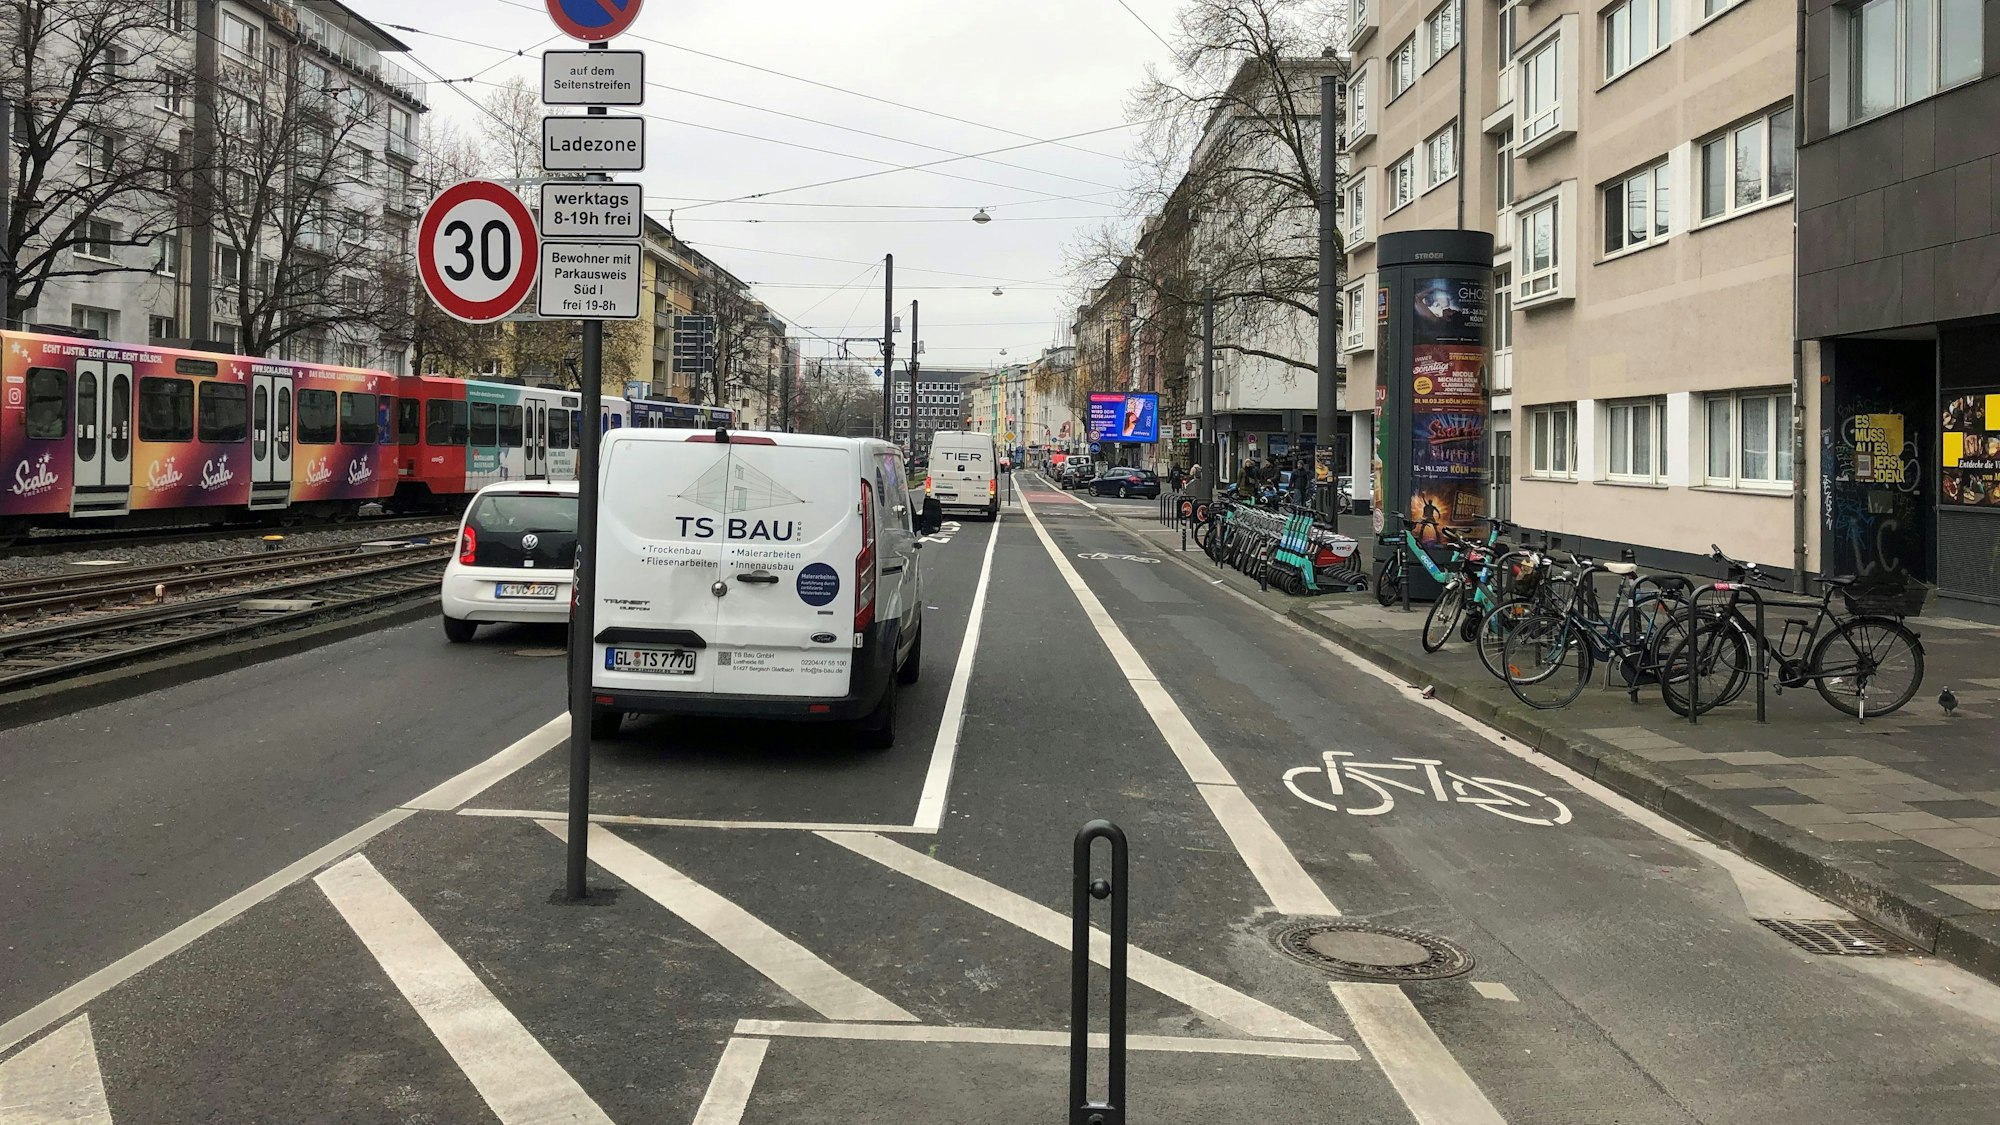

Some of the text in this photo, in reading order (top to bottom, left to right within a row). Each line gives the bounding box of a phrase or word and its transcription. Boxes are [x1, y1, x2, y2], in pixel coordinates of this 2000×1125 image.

[569, 66, 614, 76] auf dem
[553, 79, 631, 90] Seitenstreifen
[549, 136, 637, 152] Ladezone
[554, 192, 629, 206] werktags
[554, 211, 631, 226] 8-19h frei
[444, 219, 511, 281] 30
[1414, 252, 1444, 260] STRÖER
[551, 252, 631, 265] Bewohner mit
[554, 268, 627, 281] Parkausweis
[573, 283, 604, 296] Süd I
[562, 299, 617, 312] frei 19-8h
[42, 343, 62, 355] ECHT
[88, 347, 105, 359] ECHT
[122, 350, 138, 362] ECHT
[1855, 414, 1870, 428] ES
[1855, 428, 1885, 443] MUSS
[942, 451, 982, 462] TIER
[1450, 463, 1469, 474] KÖLN
[1959, 459, 1984, 469] Entdecke
[1984, 460, 1994, 469] die
[12, 459, 59, 494] Scala
[147, 460, 183, 490] Scala
[199, 459, 234, 490] Scala
[306, 459, 332, 486] Scala
[347, 458, 372, 485] Scala
[675, 516, 793, 541] TS BAU
[648, 545, 702, 556] Trockenbau
[737, 548, 802, 560] Malerarbeiten
[646, 557, 719, 569] Fliesenarbeiten
[735, 561, 795, 572] Innenausbau
[501, 583, 511, 595] K
[530, 584, 556, 596] 1202
[615, 651, 694, 669] GL TS 7770
